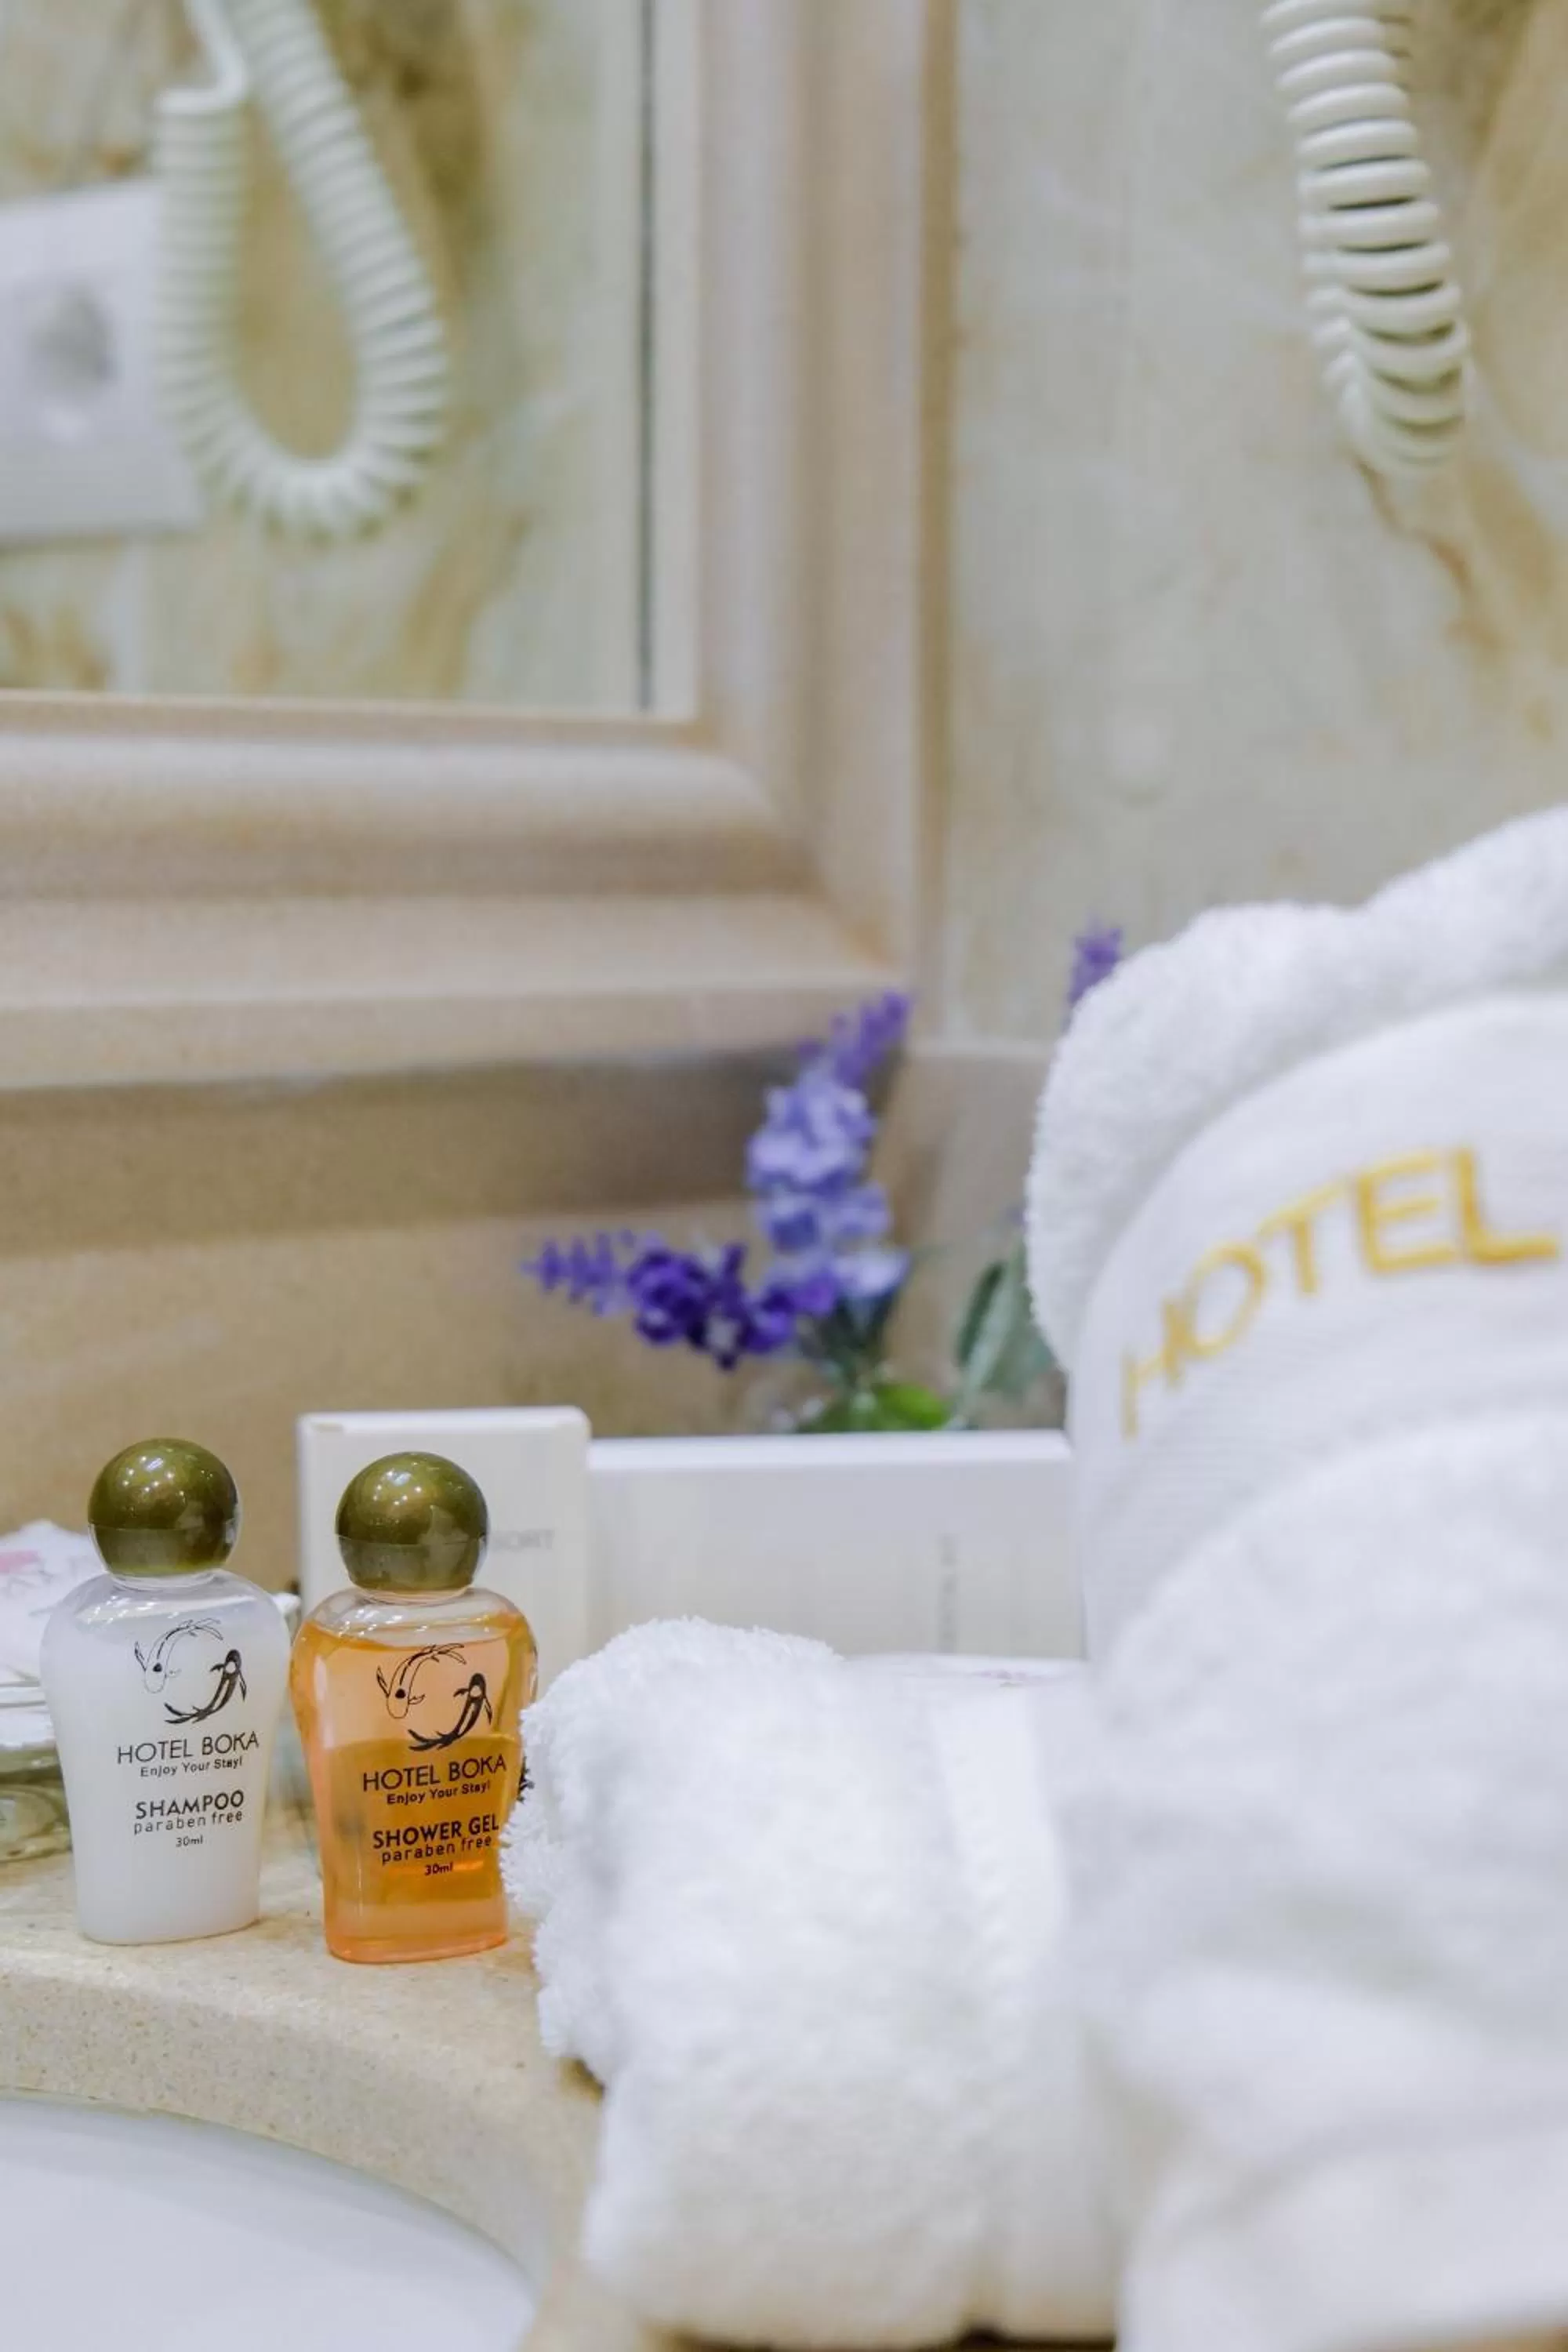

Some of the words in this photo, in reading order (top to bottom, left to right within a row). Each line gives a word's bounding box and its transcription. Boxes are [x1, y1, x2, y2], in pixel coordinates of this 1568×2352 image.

[1120, 1144, 1559, 1441] HOTEL
[117, 1738, 194, 1764] HOTEL
[201, 1730, 260, 1755] BOKA
[140, 1766, 177, 1777] Enjoy
[182, 1762, 210, 1773] Your
[362, 1765, 441, 1791] HOTEL
[448, 1753, 507, 1782] BOKA
[136, 1789, 245, 1820] SHAMPOO
[387, 1791, 426, 1806] Enjoy
[430, 1788, 458, 1799] Your
[134, 1815, 206, 1835] paraben
[211, 1810, 243, 1825] free
[372, 1820, 463, 1849] SHOWER
[467, 1813, 499, 1835] GEL
[175, 1835, 204, 1848] 30ml
[382, 1843, 456, 1866] paraben
[461, 1836, 492, 1852] free
[424, 1861, 454, 1876] 30ml
